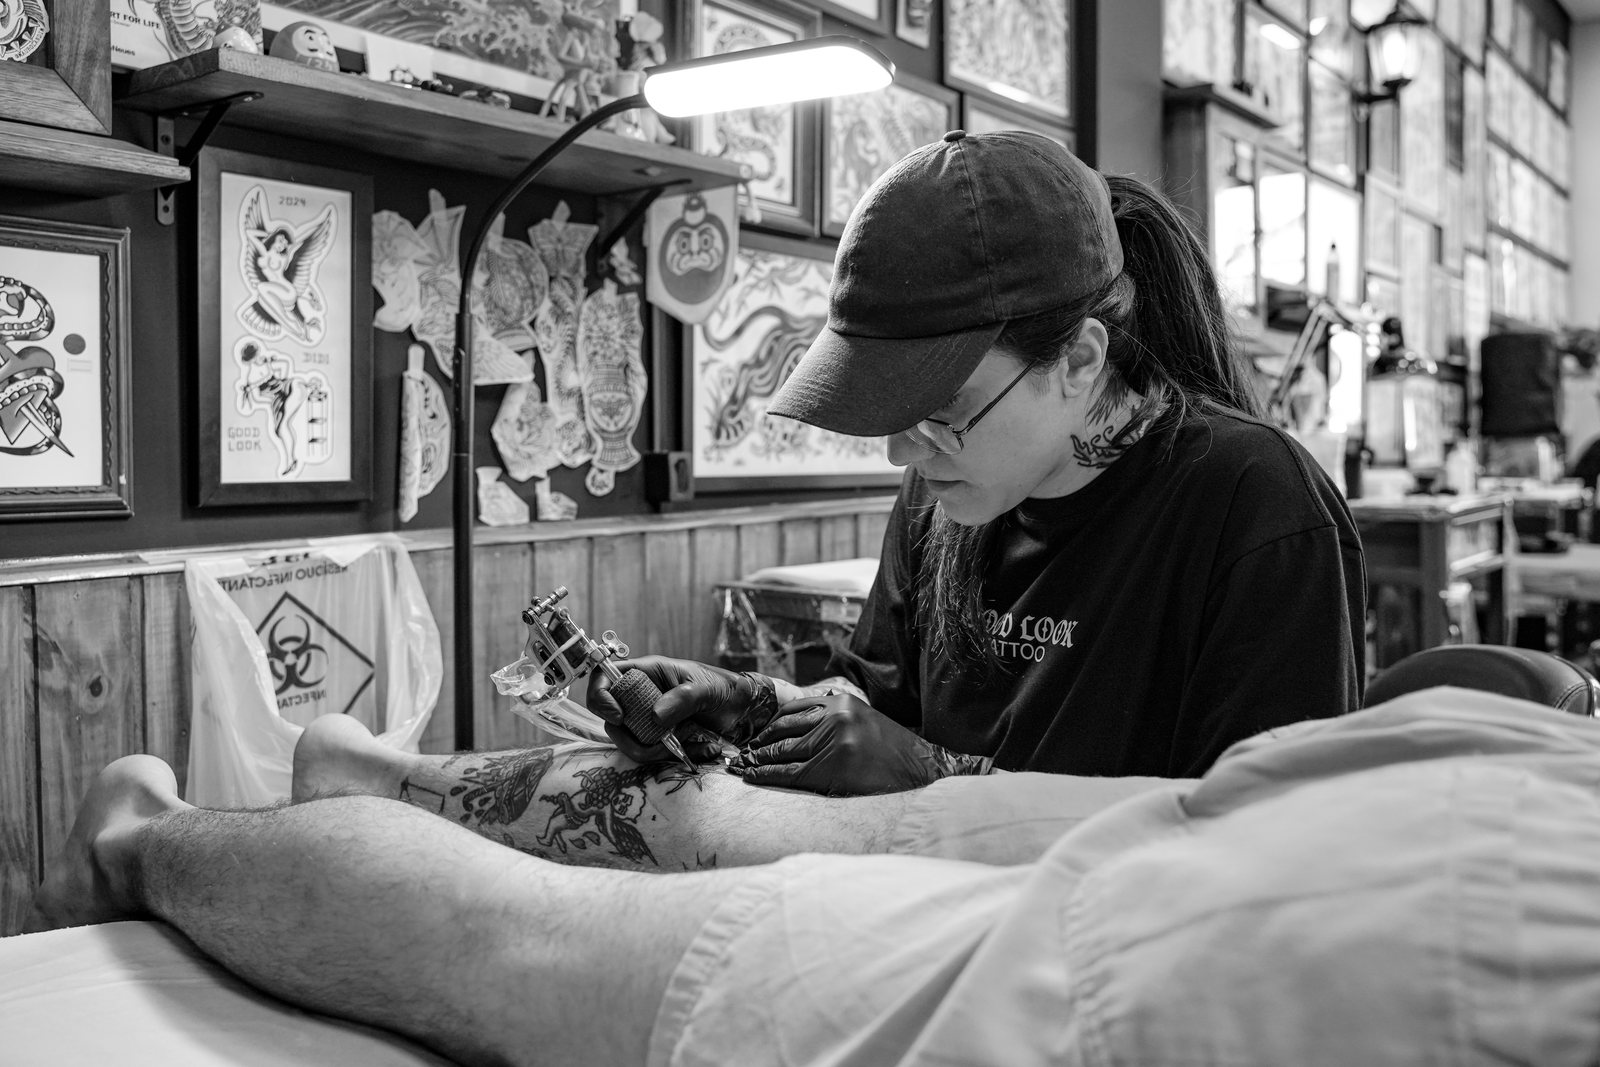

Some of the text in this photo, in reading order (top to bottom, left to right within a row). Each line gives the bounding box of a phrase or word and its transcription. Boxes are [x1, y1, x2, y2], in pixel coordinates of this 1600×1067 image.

[111, 11, 121, 20] RT
[123, 14, 141, 24] FOR
[143, 19, 161, 30] LIFE
[278, 195, 306, 207] 2024
[228, 426, 261, 440] GOOD
[228, 440, 262, 453] LOOK
[982, 608, 1079, 649] OOD LOOK
[990, 638, 1046, 663] ATTOO
